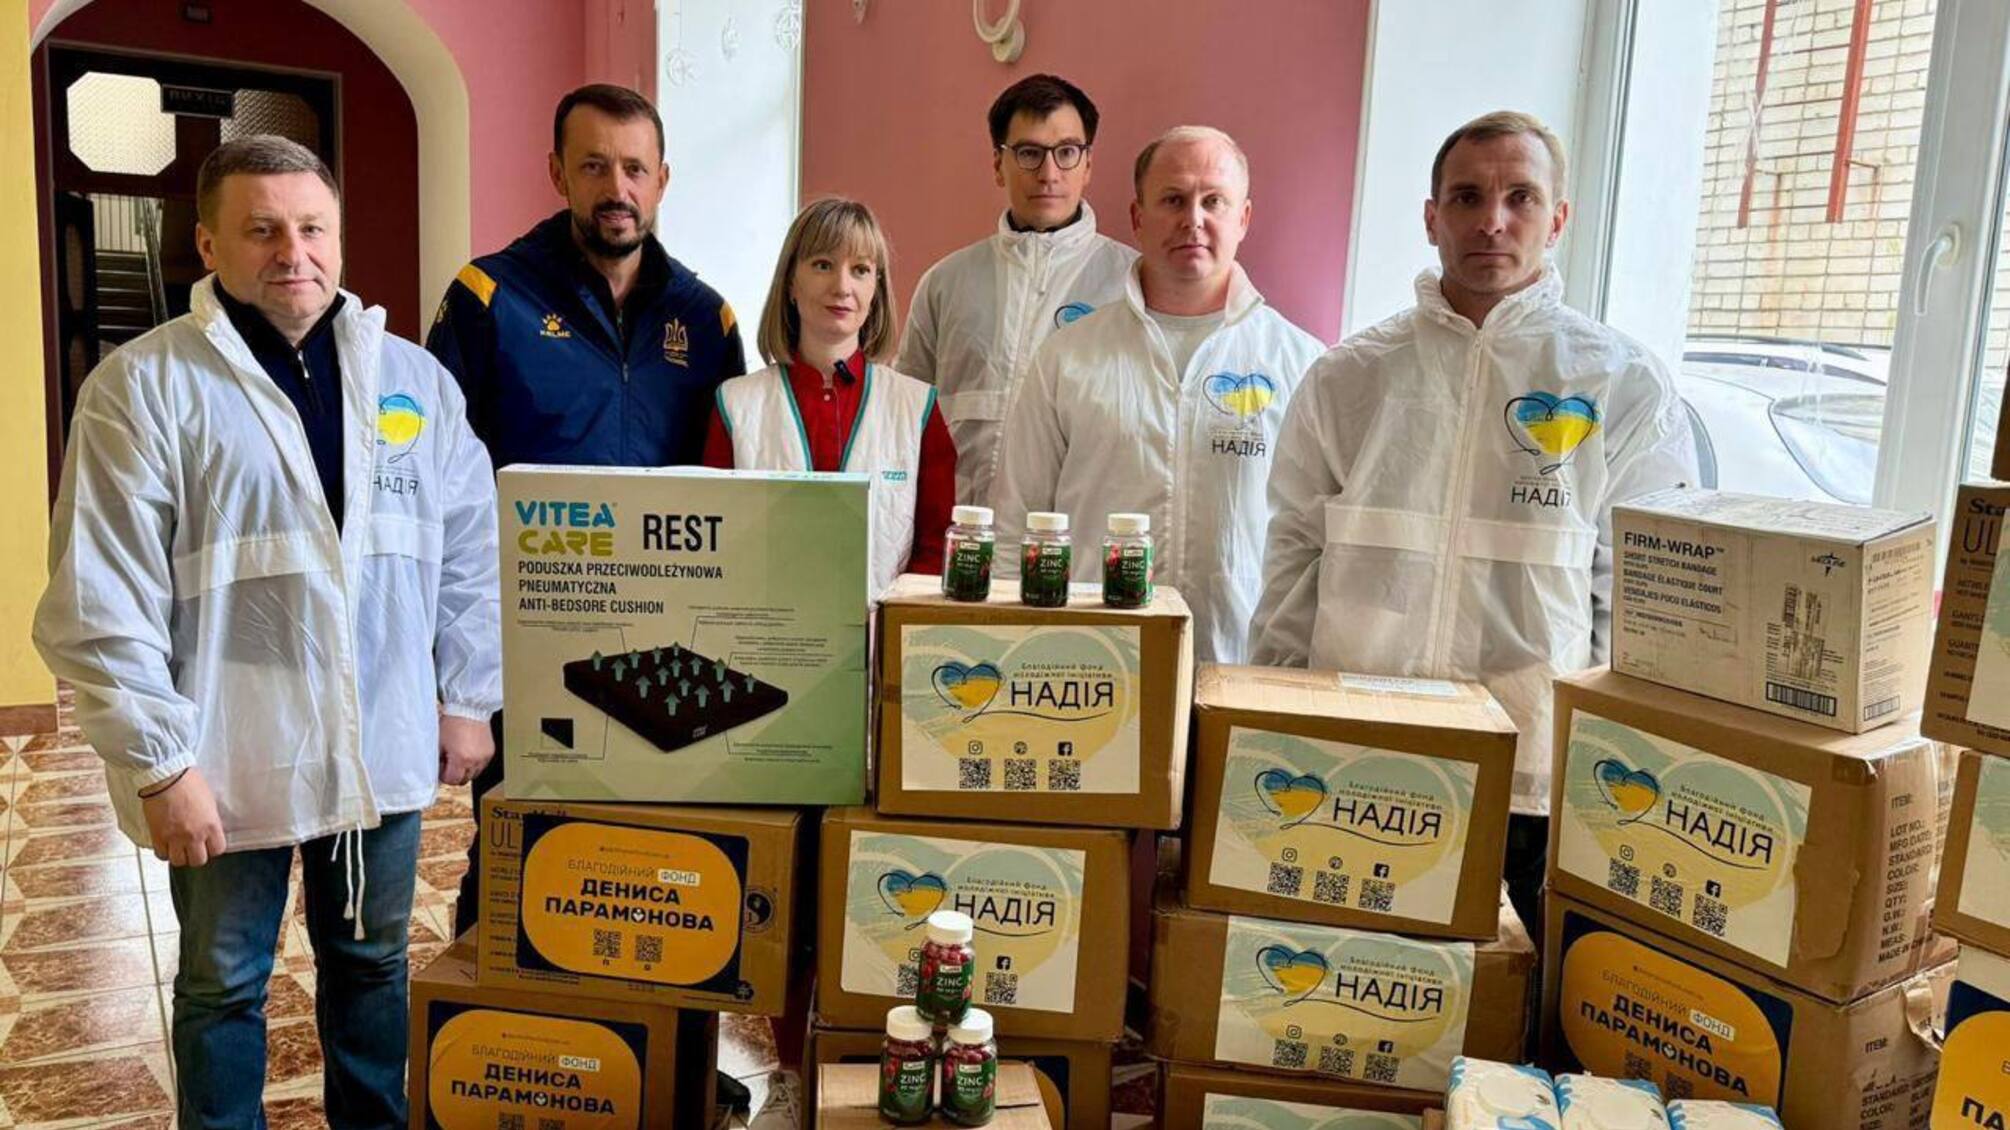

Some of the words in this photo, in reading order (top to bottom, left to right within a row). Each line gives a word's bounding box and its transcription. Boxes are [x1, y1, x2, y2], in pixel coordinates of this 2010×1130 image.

[1212, 439, 1266, 457] НАДІЯ
[515, 500, 616, 528] VITEA
[517, 530, 613, 556] CARE
[642, 514, 723, 552] REST
[518, 561, 583, 576] PODUSZKA
[586, 562, 723, 579] PRZECIWODLEŻYNOWA
[957, 553, 981, 563] ZINC
[1039, 557, 1063, 568] ZINC
[1121, 559, 1145, 570] ZINC
[1648, 555, 1680, 568] STRETCH
[1681, 561, 1717, 576] BANDAGE
[518, 579, 617, 595] PNEUMATYCZNA
[1623, 568, 1655, 582] BANDAGE
[1698, 583, 1723, 595] COURT
[519, 598, 606, 614] ANTI-BEDSORE
[610, 600, 664, 614] CUSHION
[1010, 681, 1114, 710] НАДІЯ
[1332, 797, 1442, 838] НАДІЯ
[1890, 822, 1908, 838] LOT
[1665, 799, 1773, 865] НАДІЯ
[568, 858, 656, 878] БЛАГОДІЙНИЙ
[660, 870, 697, 885] ФОНД
[580, 879, 681, 905] ДЕНИСА
[544, 897, 714, 931] ПАРАМОНОВА
[954, 893, 1056, 926] НАДІЯ
[936, 977, 964, 987] ZINC
[1335, 973, 1443, 1014] НАДІЯ
[1613, 994, 1713, 1055] ДЕНИСА
[1692, 1012, 1730, 1038] ФОНД
[1580, 1001, 1749, 1096] ПАРАМОНОВА
[483, 1063, 581, 1090] ДЕНИСА
[561, 1058, 597, 1071] ФОНД
[900, 1072, 927, 1085] ZINC
[957, 1076, 983, 1087] ZINC
[451, 1080, 616, 1115] ПАРАМОНОВА
